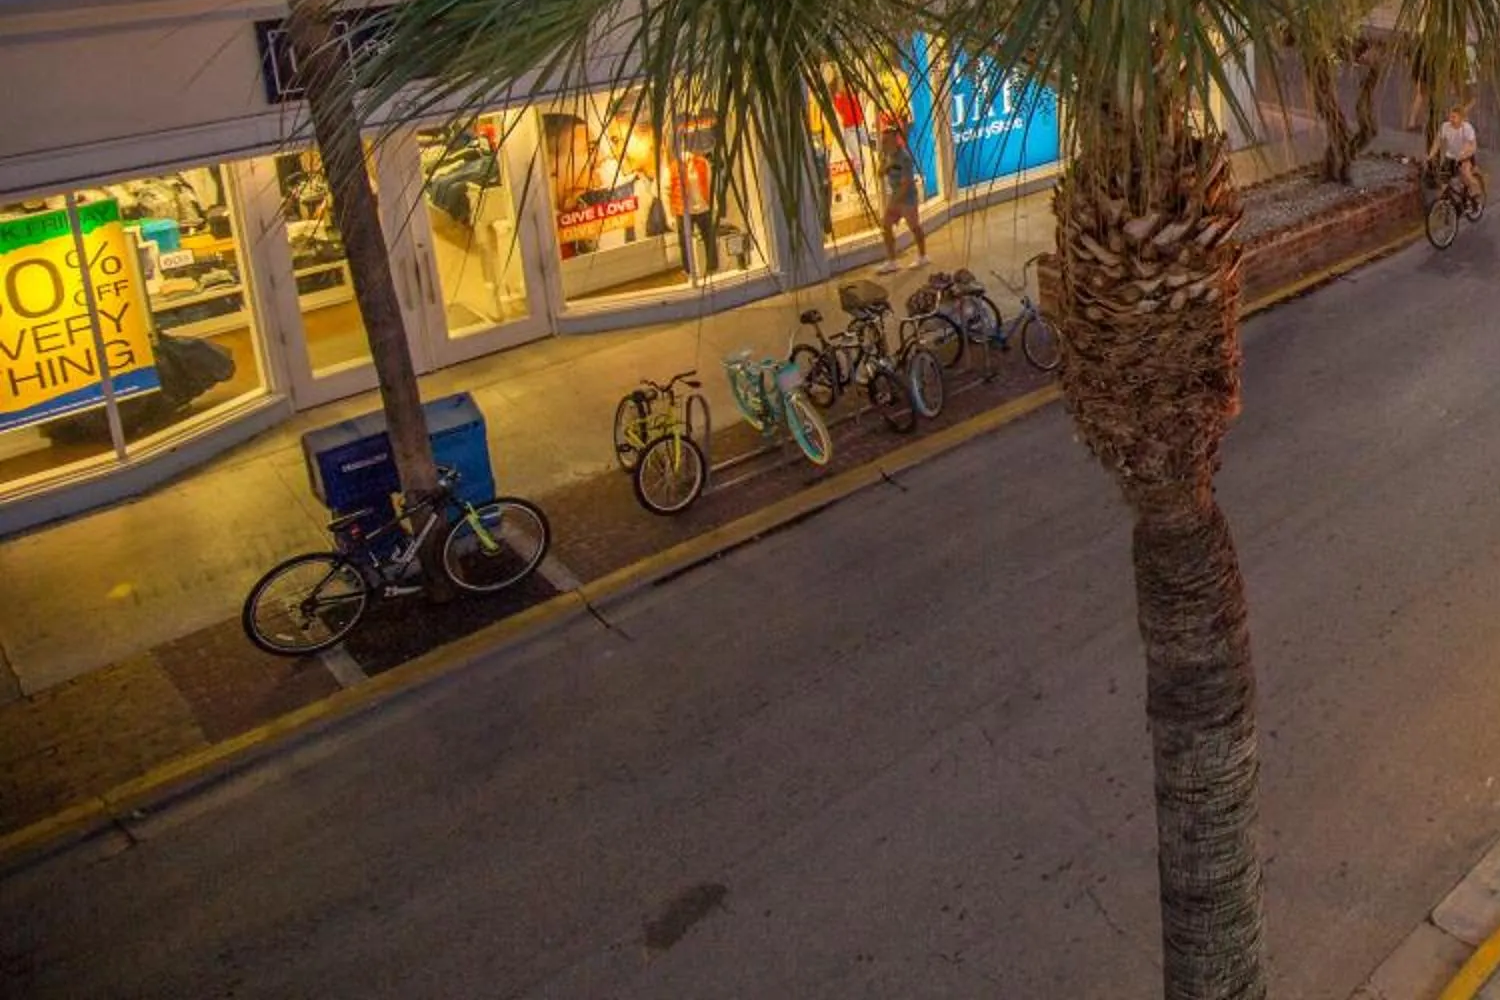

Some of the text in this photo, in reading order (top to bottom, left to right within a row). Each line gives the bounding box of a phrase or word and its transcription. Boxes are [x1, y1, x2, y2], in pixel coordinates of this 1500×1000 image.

[0, 241, 122, 319] 0%
[0, 302, 130, 361] VERY
[0, 339, 136, 397] HING
